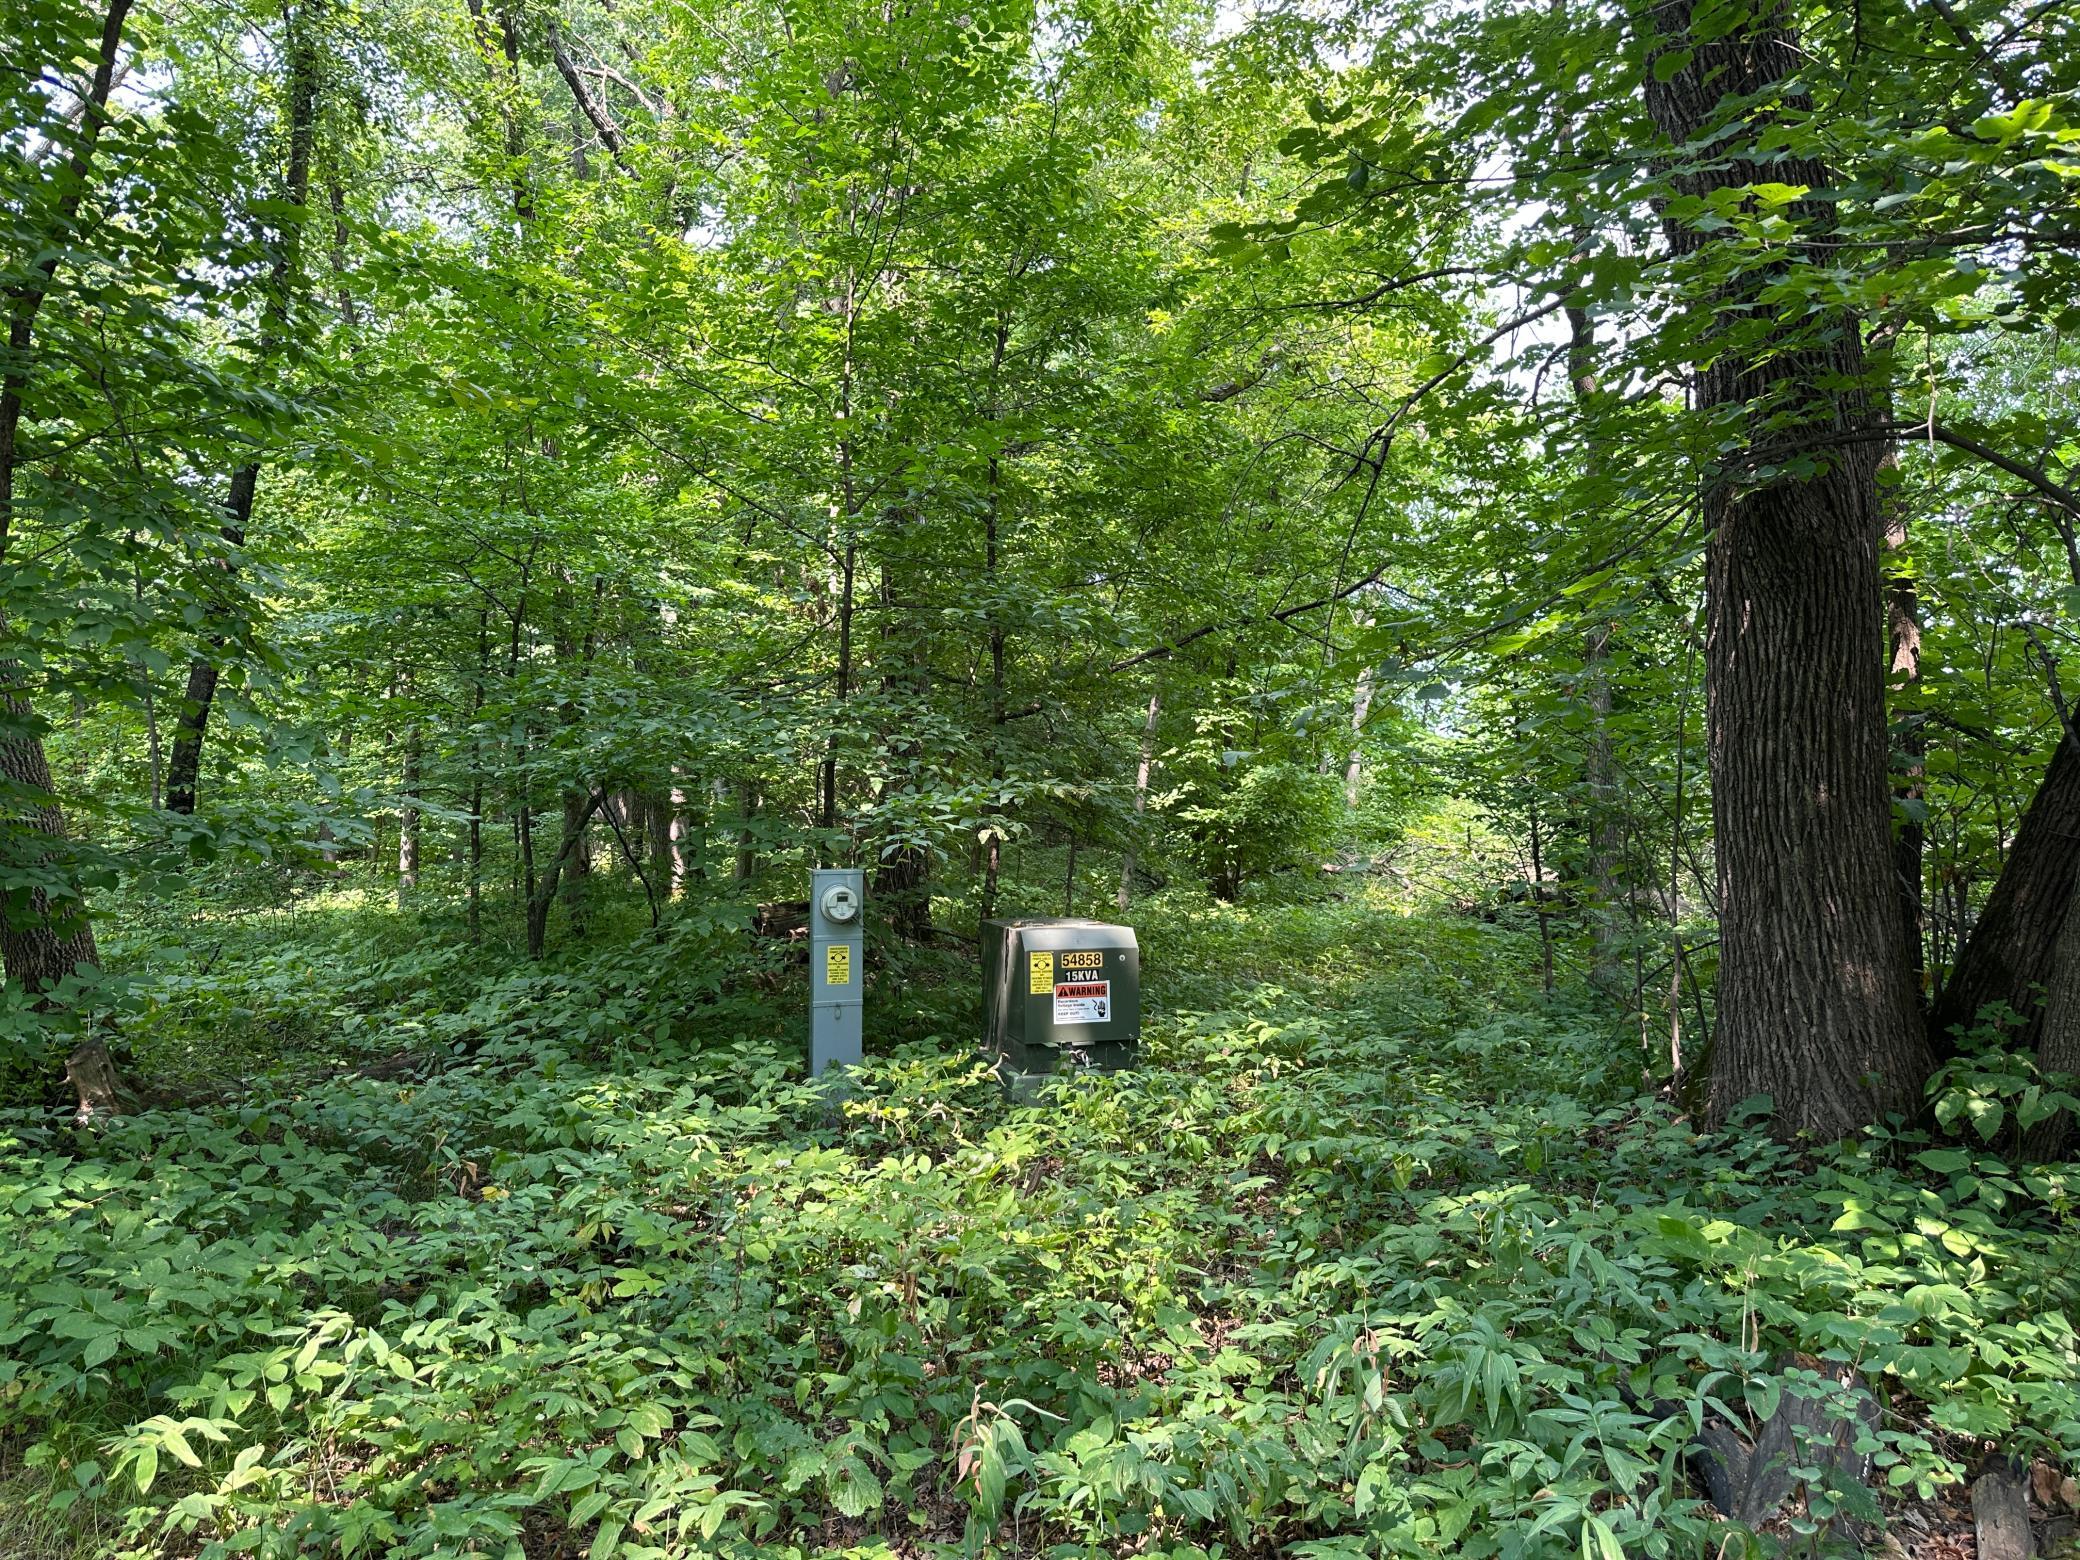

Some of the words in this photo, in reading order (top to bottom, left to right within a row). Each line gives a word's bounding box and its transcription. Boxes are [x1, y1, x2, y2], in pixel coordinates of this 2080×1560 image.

[1062, 953, 1101, 966] 54858
[1066, 970, 1098, 981] 15KVA
[1069, 986, 1105, 996] WARNING
